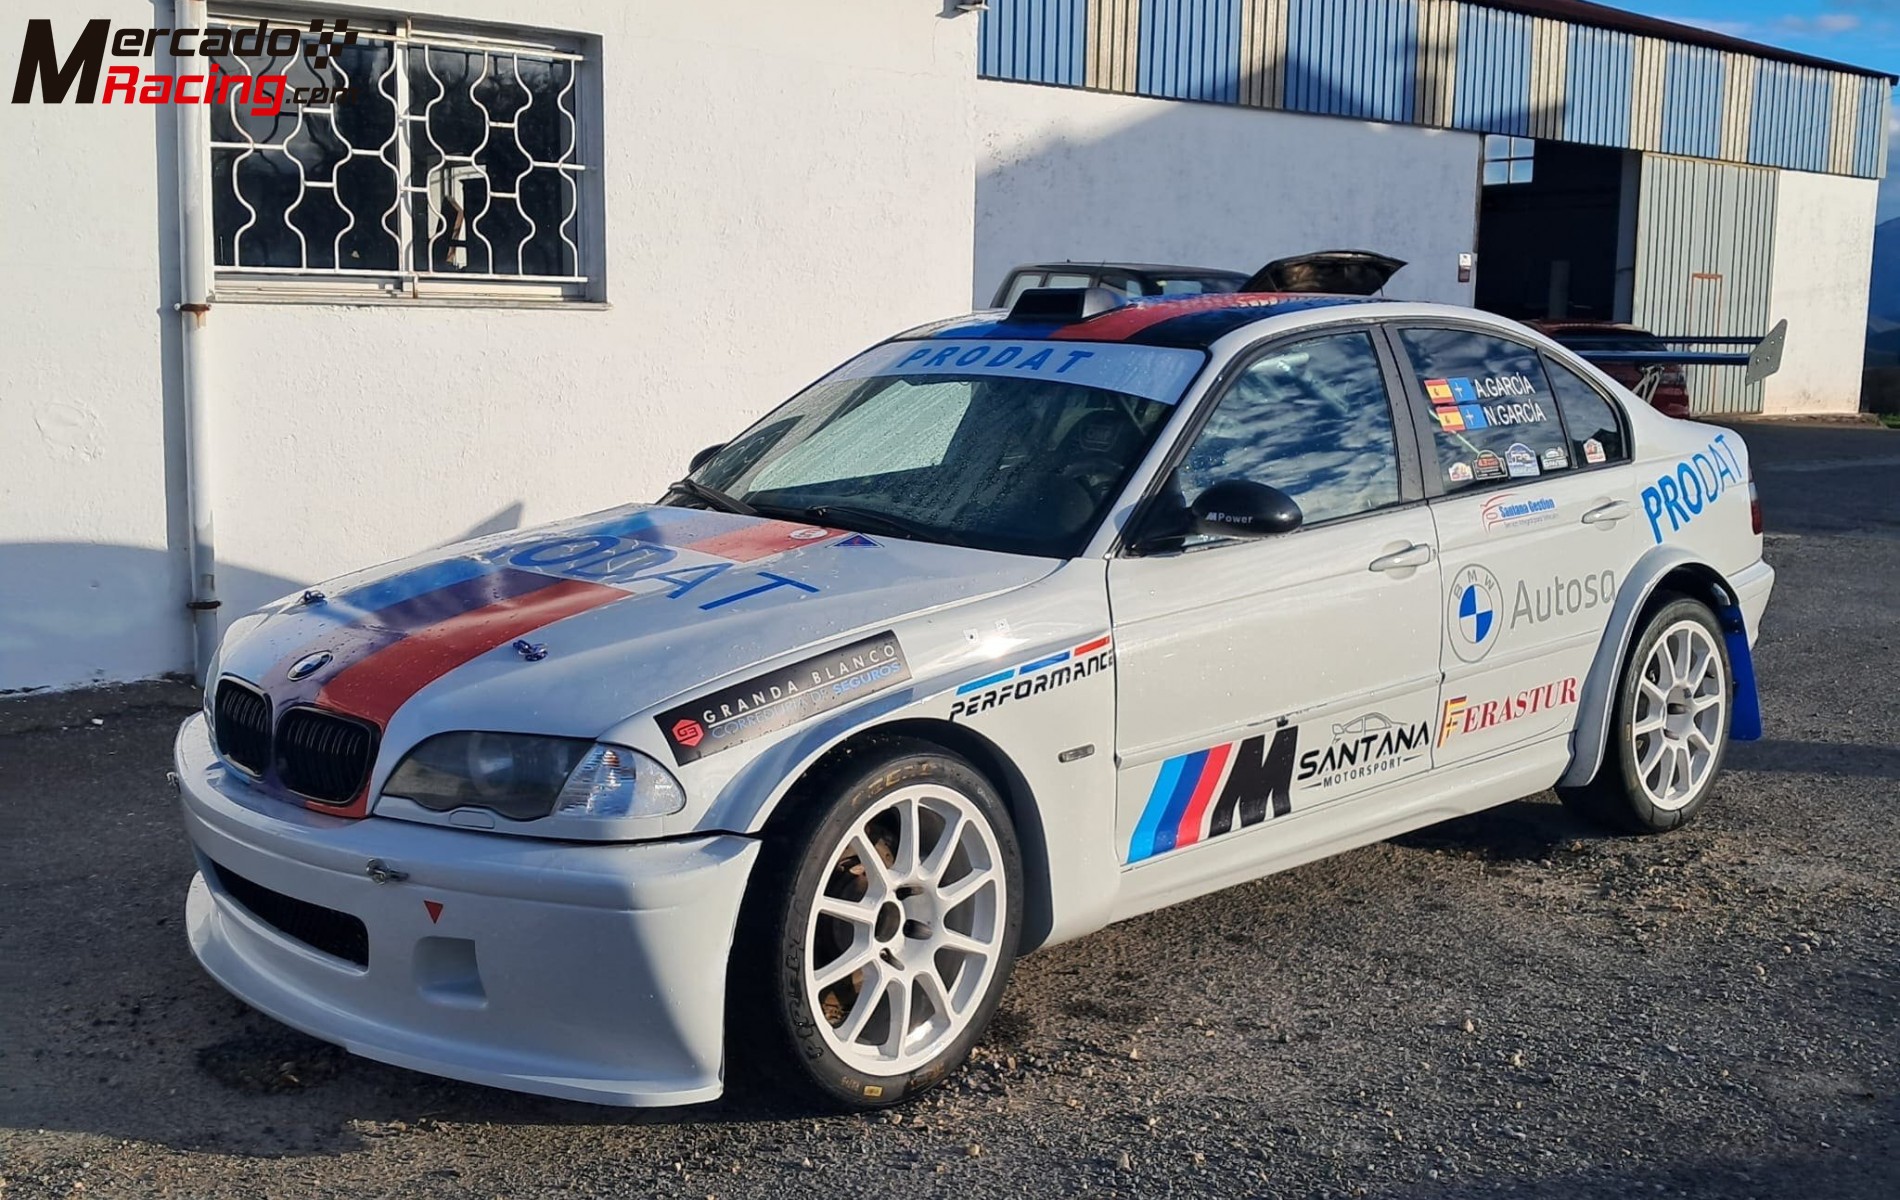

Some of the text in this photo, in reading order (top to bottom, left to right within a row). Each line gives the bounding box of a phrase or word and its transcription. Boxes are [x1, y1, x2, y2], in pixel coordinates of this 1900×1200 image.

[896, 346, 1095, 373] PRODAT
[1474, 372, 1536, 398] A.GARCÍA
[1484, 399, 1547, 427] N.GARCÍA
[1641, 434, 1742, 544] PRODAT
[1218, 512, 1253, 523] Power
[1498, 504, 1530, 518] Santana
[485, 535, 819, 611] ODAT
[1453, 570, 1505, 600] BMW
[702, 645, 896, 724] GRANDA BLANCO
[832, 661, 903, 695] SEGUROS
[1437, 678, 1578, 749] FERASTUR
[1297, 720, 1430, 781] SANTANA
[1323, 756, 1402, 788] MOTORSPORT
